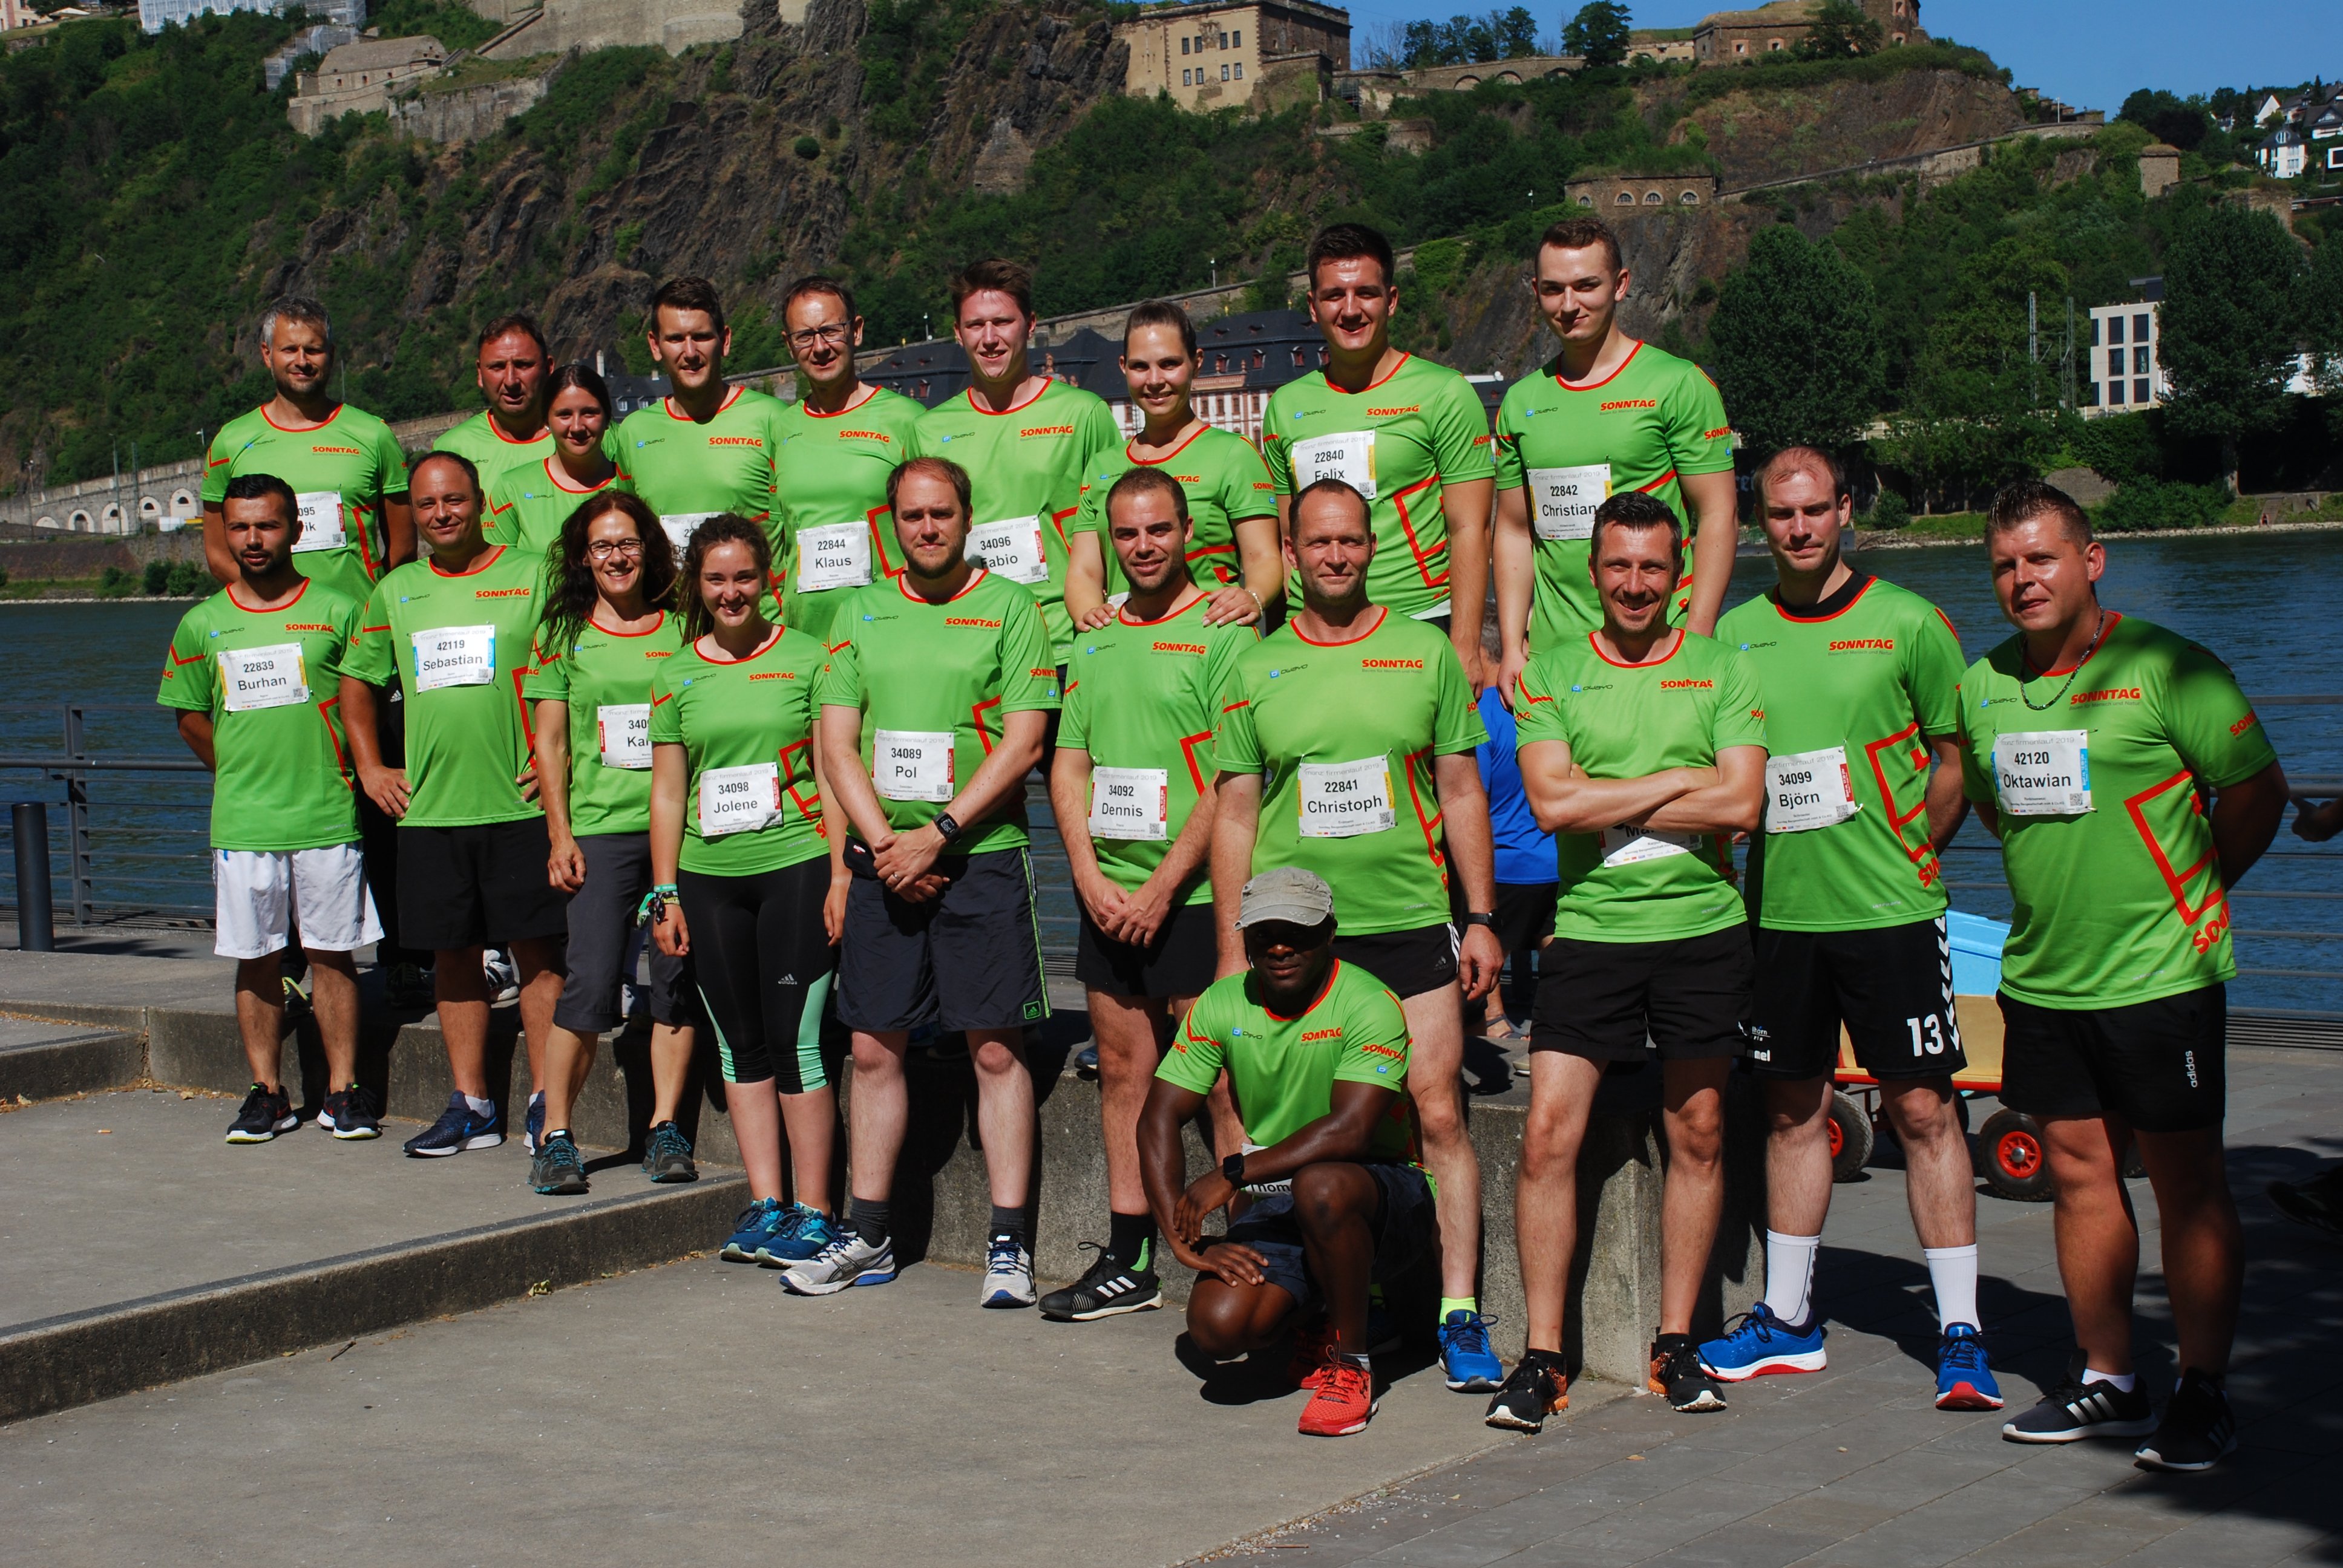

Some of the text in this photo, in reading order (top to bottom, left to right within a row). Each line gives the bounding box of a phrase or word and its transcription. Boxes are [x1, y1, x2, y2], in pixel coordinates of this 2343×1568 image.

[1367, 405, 1420, 416] SONNTAG
[1601, 400, 1656, 411] SONNTAG
[840, 431, 890, 443] SONNTAG
[1021, 425, 1073, 437] SONNTAG
[709, 437, 762, 447] SONNTAG
[1315, 450, 1343, 463] 22840
[1315, 468, 1345, 482] Felix
[1550, 485, 1578, 496] 22842
[298, 506, 316, 518] 095
[1542, 503, 1596, 517] Christian
[818, 540, 845, 550] 22844
[980, 537, 1011, 550] 34096
[816, 558, 851, 568] Klaus
[980, 554, 1018, 569] Fabio
[476, 588, 530, 598] SONNTAG
[286, 624, 333, 632] SONNTAG
[945, 618, 1001, 628] SONNTAG
[437, 639, 465, 651] 42119
[1153, 642, 1206, 655] SONNTAG
[1829, 639, 1893, 651] SONNTAG
[244, 661, 274, 672] 22839
[424, 655, 483, 671] Sebastian
[1362, 659, 1423, 668] SONNTAG
[238, 678, 286, 690] Burhan
[2071, 688, 2141, 705] SONNTAG
[628, 719, 649, 730] 340
[891, 748, 921, 759] 34089
[1817, 754, 1834, 763] 2019
[2014, 752, 2049, 765] 42120
[896, 766, 916, 777] Pol
[1326, 766, 1362, 776] firmenlauf
[1779, 771, 1812, 785] 34099
[2004, 773, 2071, 788] Oktawian
[719, 782, 749, 794] 34098
[1109, 785, 1133, 796] 34092
[1325, 779, 1357, 792] 22841
[1308, 795, 1381, 812] Christoph
[1779, 792, 1820, 809] Björn
[714, 801, 757, 813] Jolene
[1103, 803, 1142, 816] Dennis
[1907, 1014, 1944, 1057] 13
[2185, 1050, 2198, 1088] adidas
